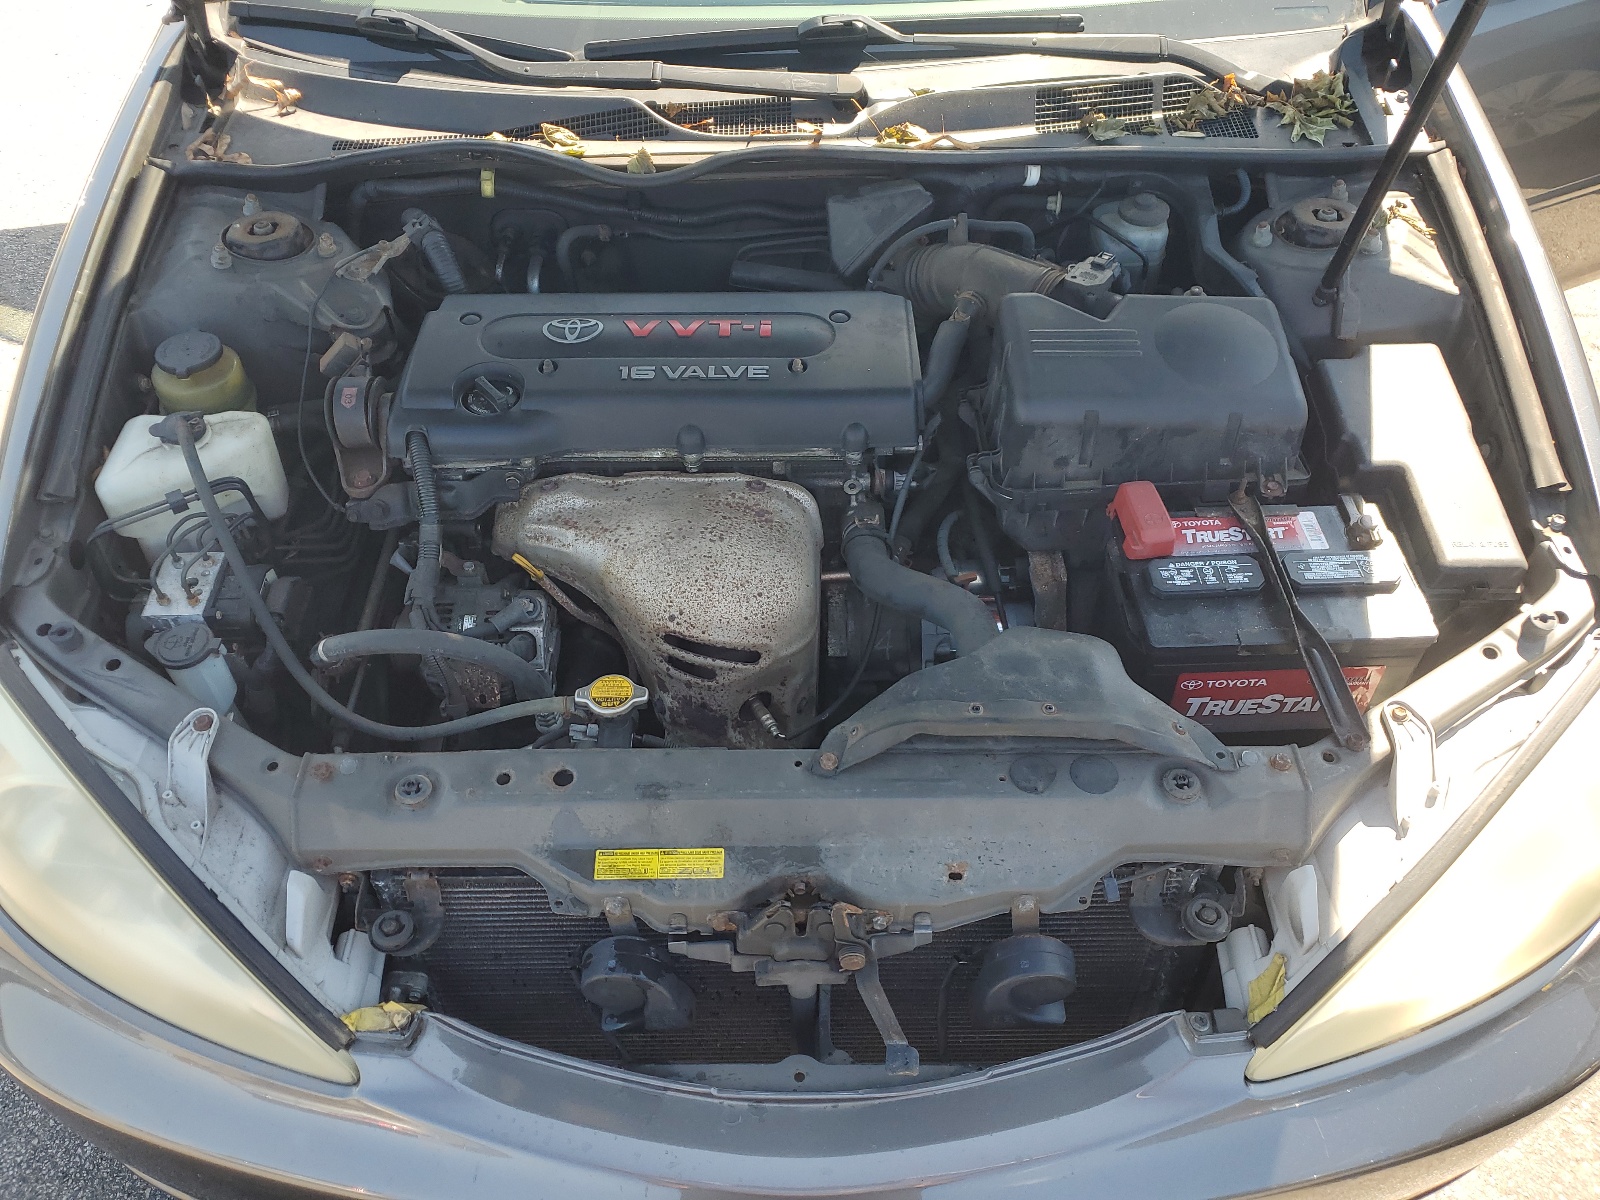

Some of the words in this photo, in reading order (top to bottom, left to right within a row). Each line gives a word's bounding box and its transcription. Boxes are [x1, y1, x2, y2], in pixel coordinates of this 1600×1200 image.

[623, 319, 772, 338] VVT-i
[619, 365, 657, 380] 16
[661, 365, 770, 380] VALVE
[1182, 519, 1222, 527] TOYOTA
[1207, 678, 1268, 689] TOYOTA
[1186, 694, 1322, 717] TRUESTA
